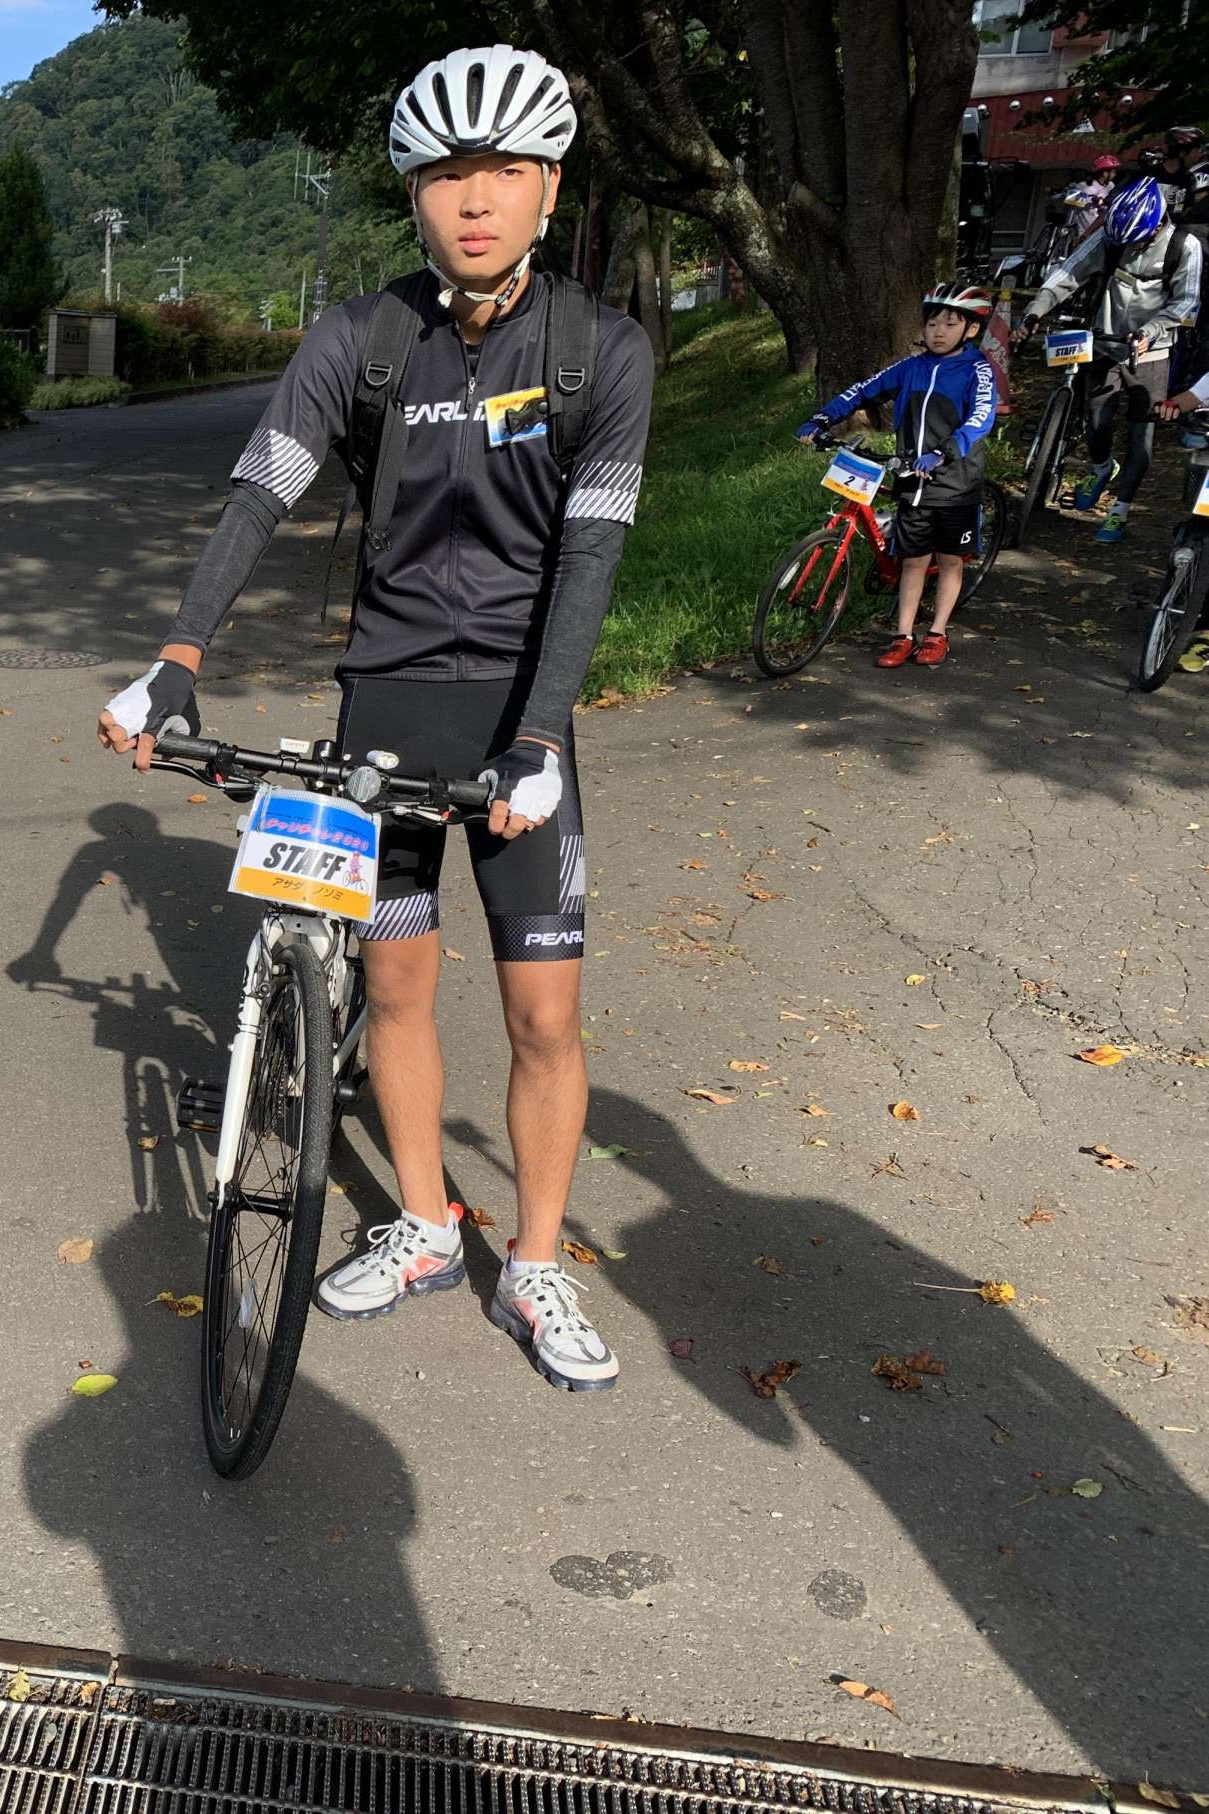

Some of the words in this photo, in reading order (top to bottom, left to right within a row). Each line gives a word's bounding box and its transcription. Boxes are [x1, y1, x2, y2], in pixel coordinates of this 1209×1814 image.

[1055, 346, 1078, 357] STAFF
[844, 476, 856, 486] 2
[263, 842, 347, 881] STAFF
